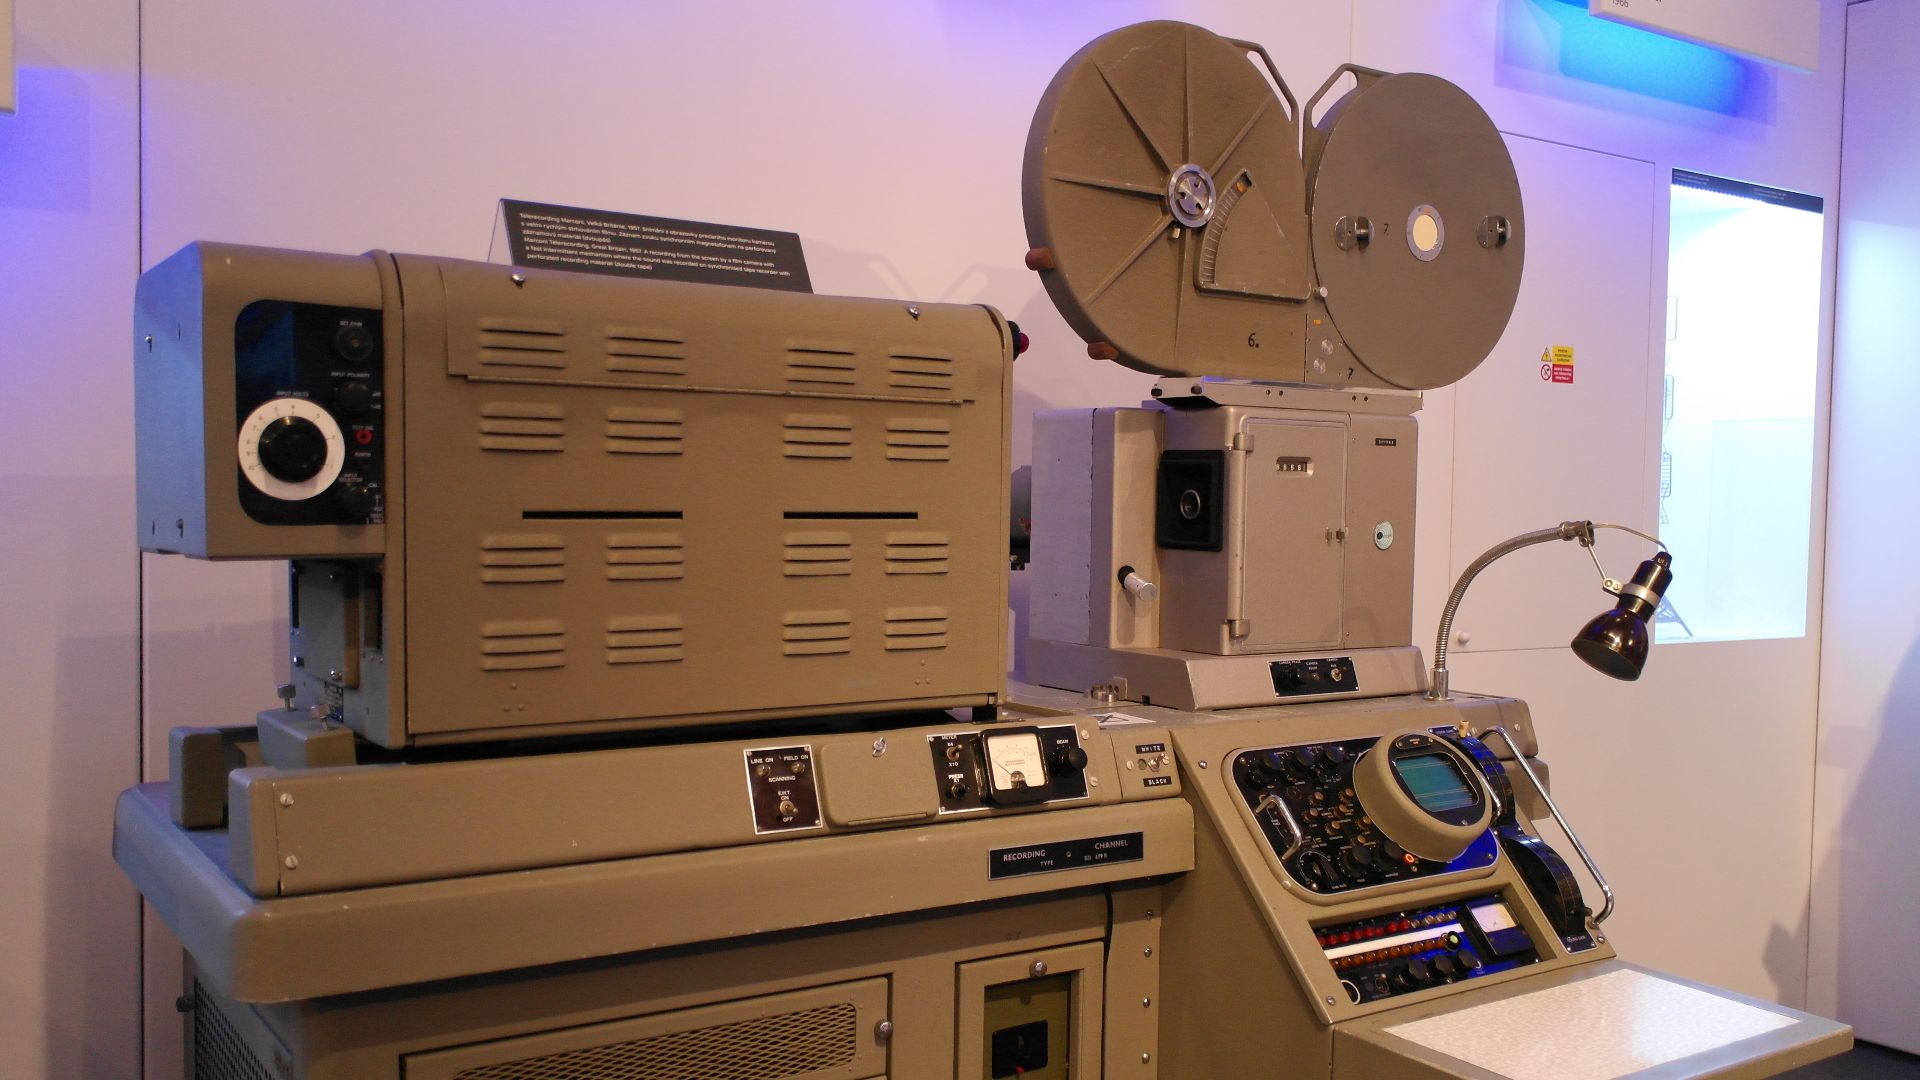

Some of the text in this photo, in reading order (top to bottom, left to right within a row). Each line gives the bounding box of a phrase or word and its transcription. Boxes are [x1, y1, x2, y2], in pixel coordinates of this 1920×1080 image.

[768, 775, 796, 783] SCANNING
[1003, 839, 1129, 862] RECORDING CHANNEL
[1040, 859, 1054, 867] TYPE
